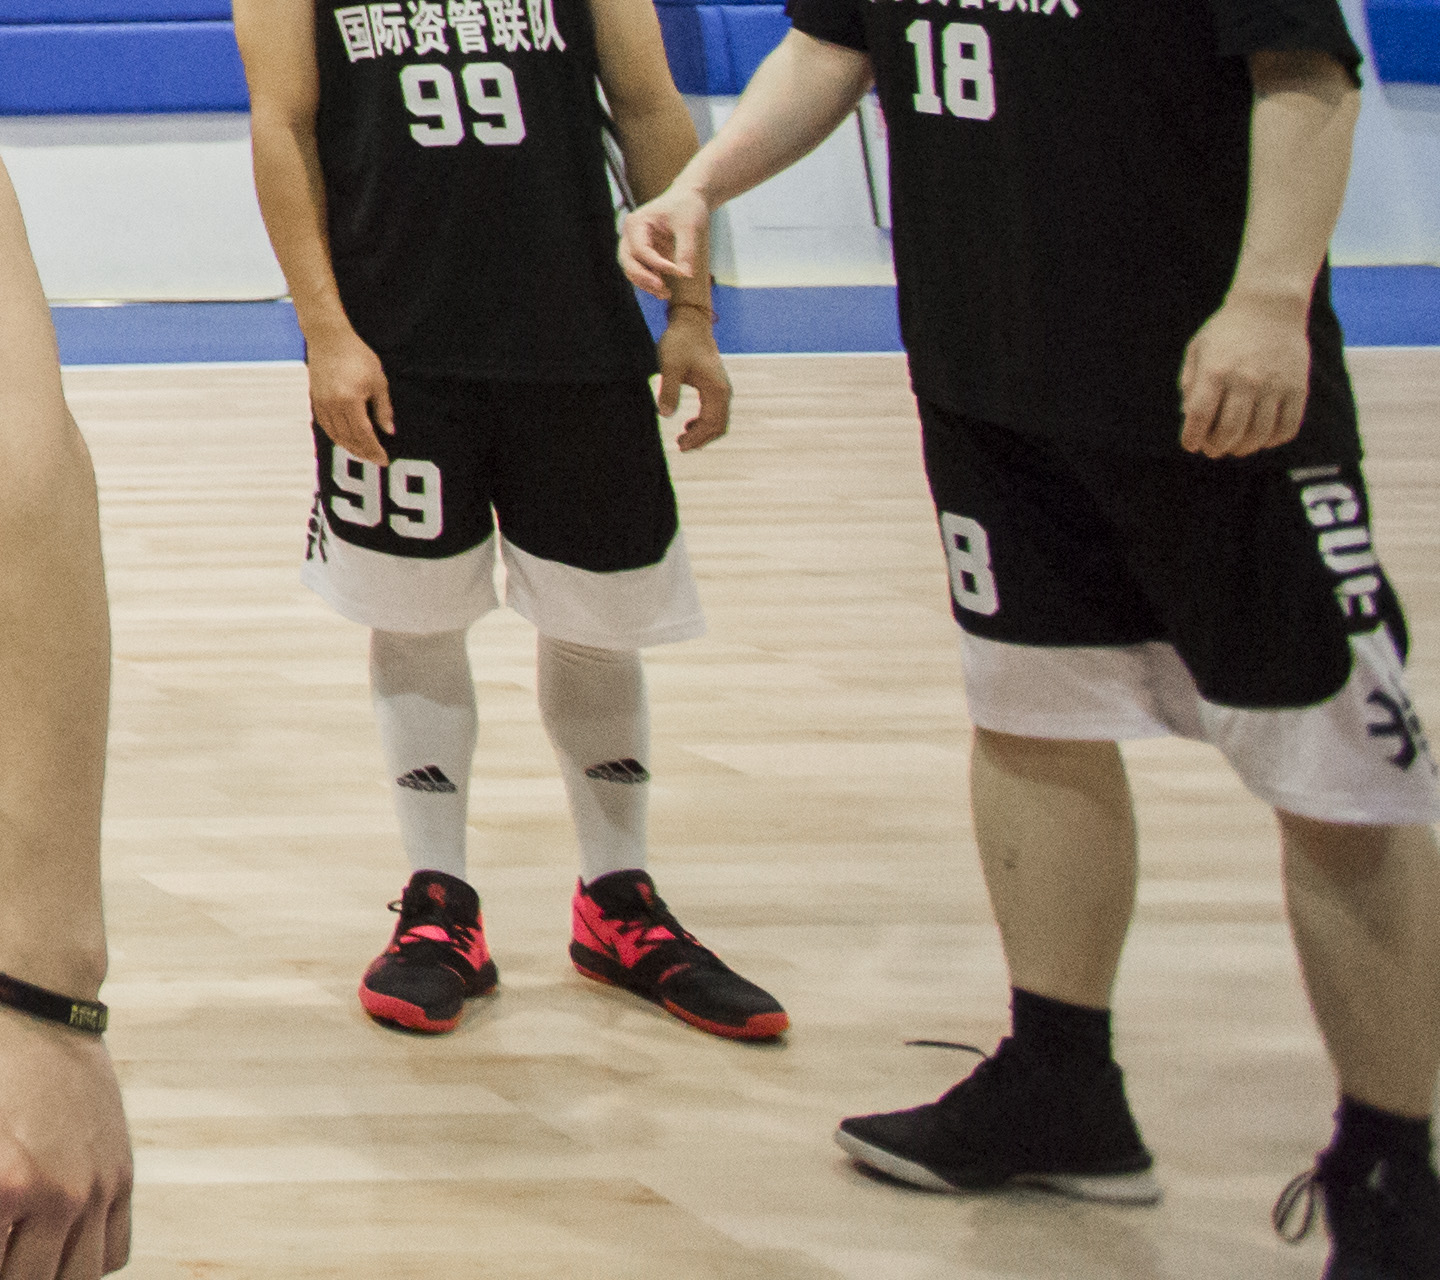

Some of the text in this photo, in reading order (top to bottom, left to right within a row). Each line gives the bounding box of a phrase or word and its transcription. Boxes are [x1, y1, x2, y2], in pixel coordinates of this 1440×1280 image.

[399, 62, 528, 147] 99
[905, 19, 997, 121] 18
[331, 443, 443, 540] 99
